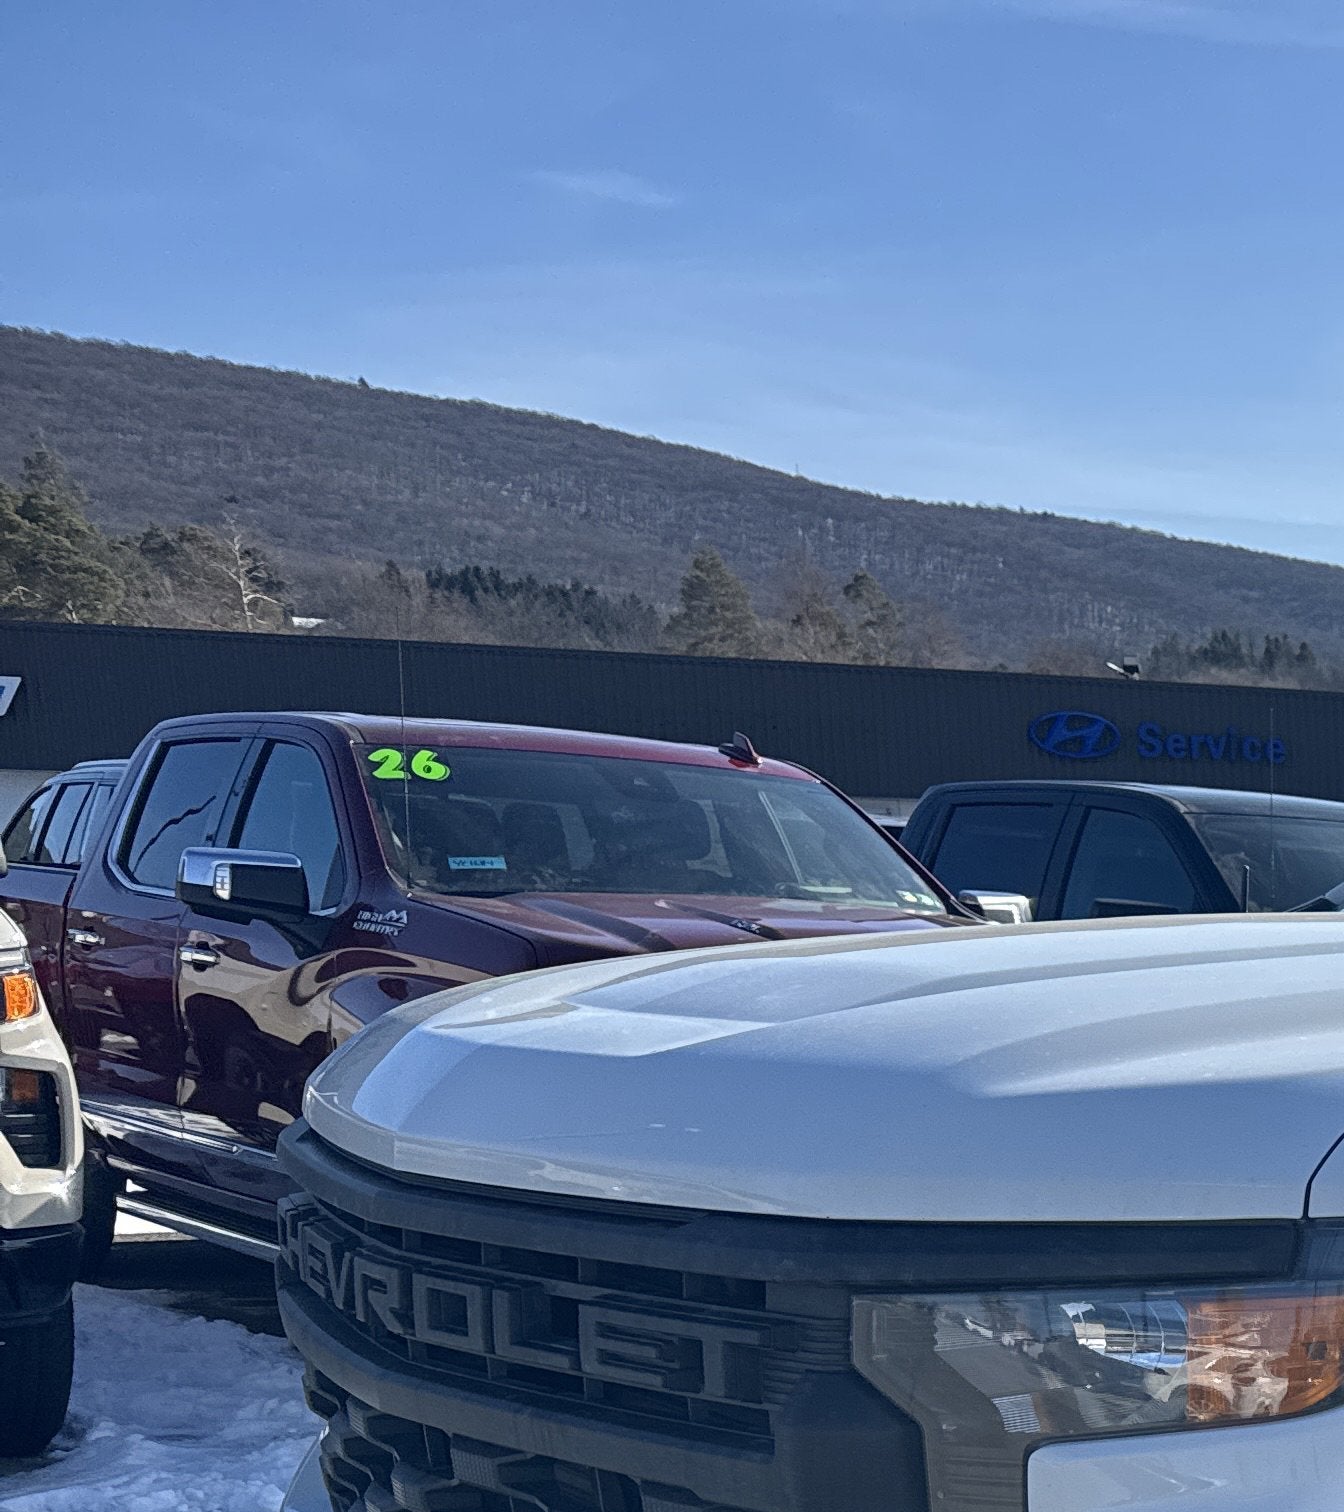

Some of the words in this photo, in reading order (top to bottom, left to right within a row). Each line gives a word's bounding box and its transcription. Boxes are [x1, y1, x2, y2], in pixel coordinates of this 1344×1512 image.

[1136, 720, 1287, 764] Service
[367, 748, 451, 781] 26
[279, 1202, 764, 1398] HEVROLET
